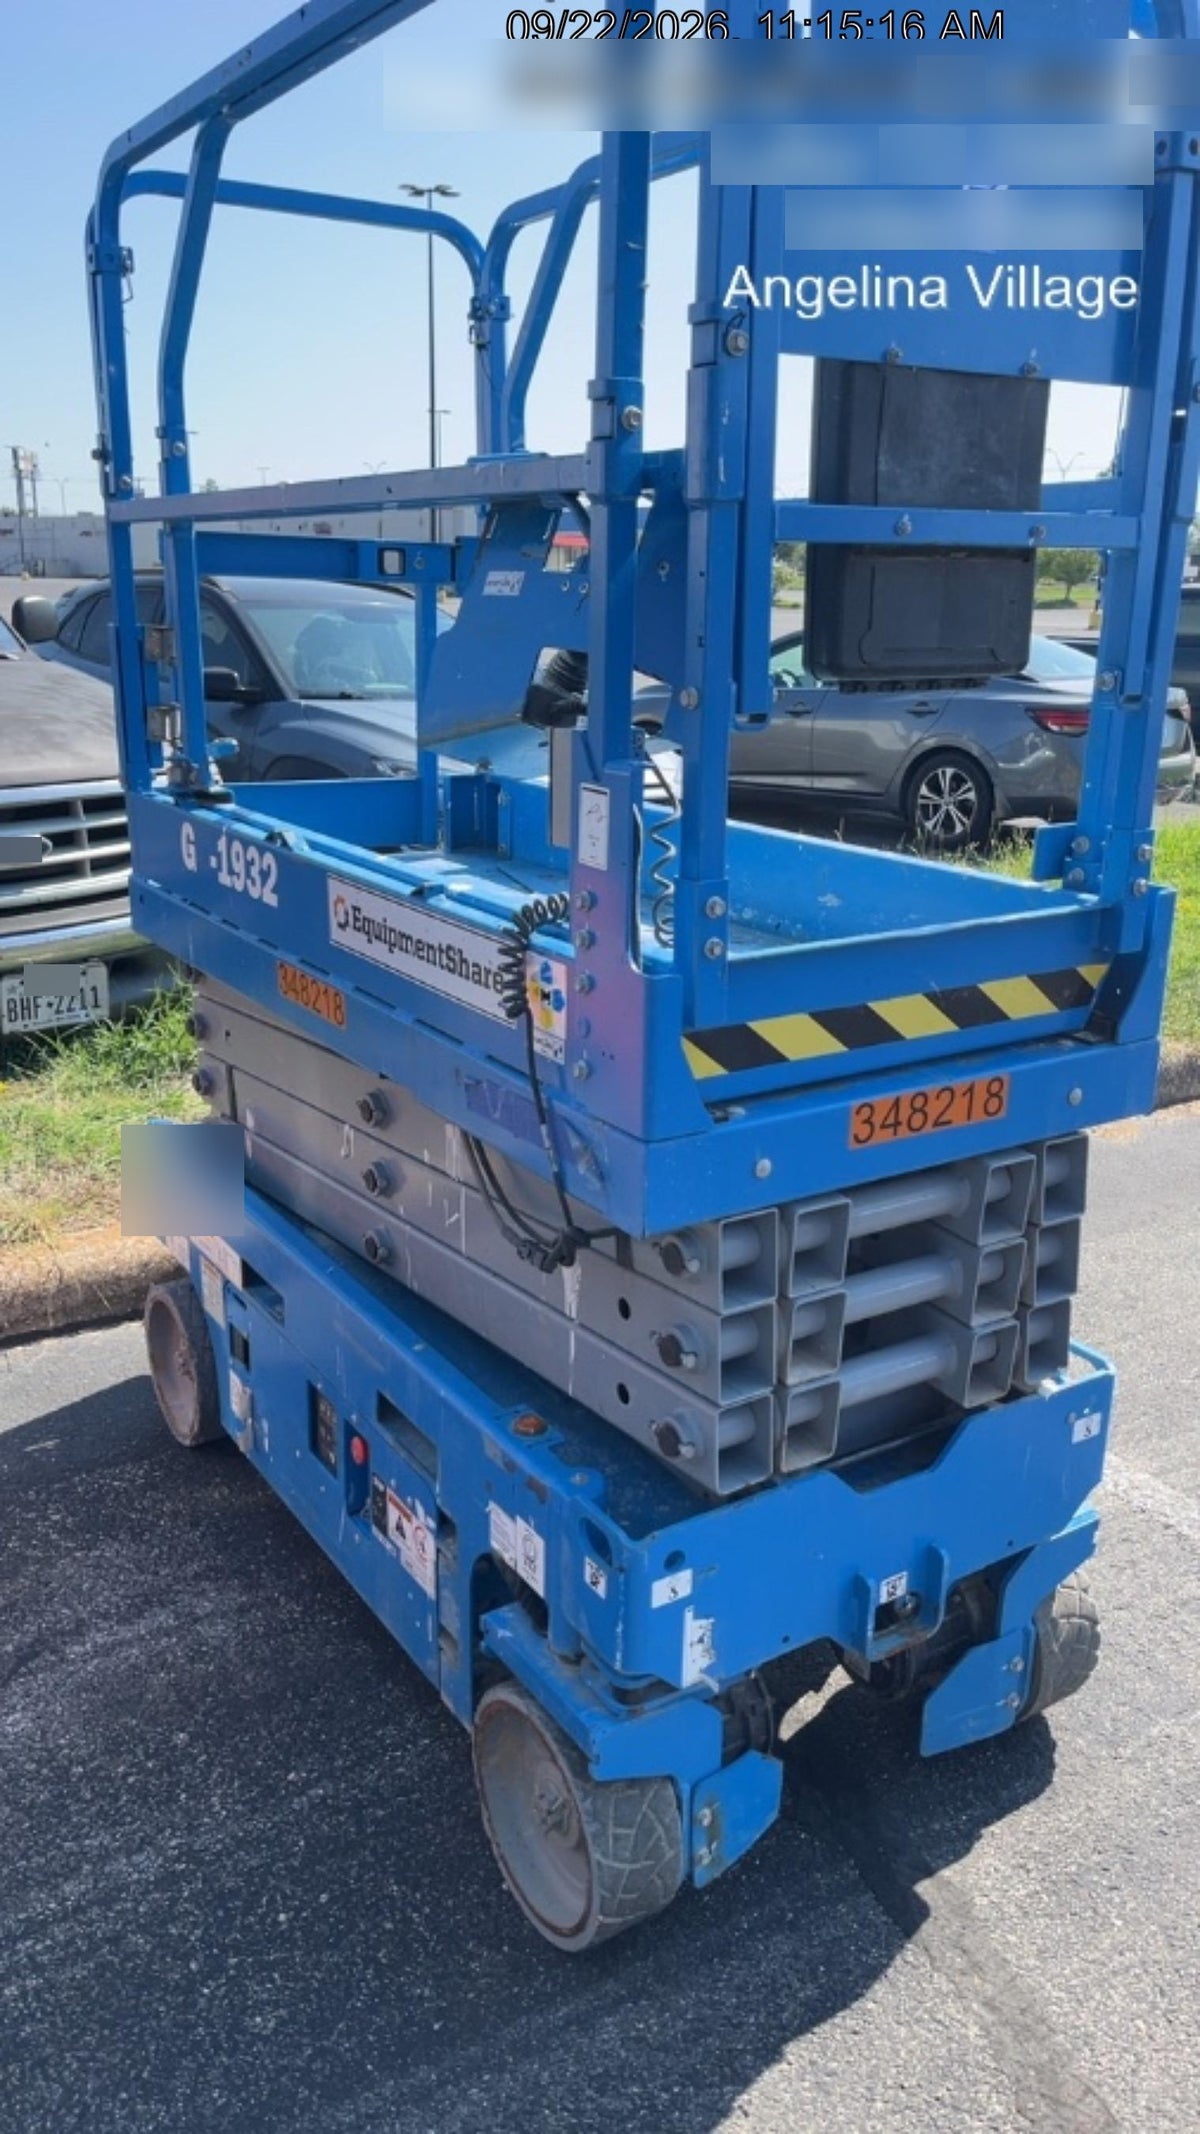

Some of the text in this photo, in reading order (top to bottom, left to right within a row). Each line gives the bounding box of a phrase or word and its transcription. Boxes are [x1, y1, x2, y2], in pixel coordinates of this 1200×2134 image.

[351, 904, 504, 995] EquipmentShare
[279, 962, 344, 1026] 348218
[852, 1075, 1004, 1145] 348218
